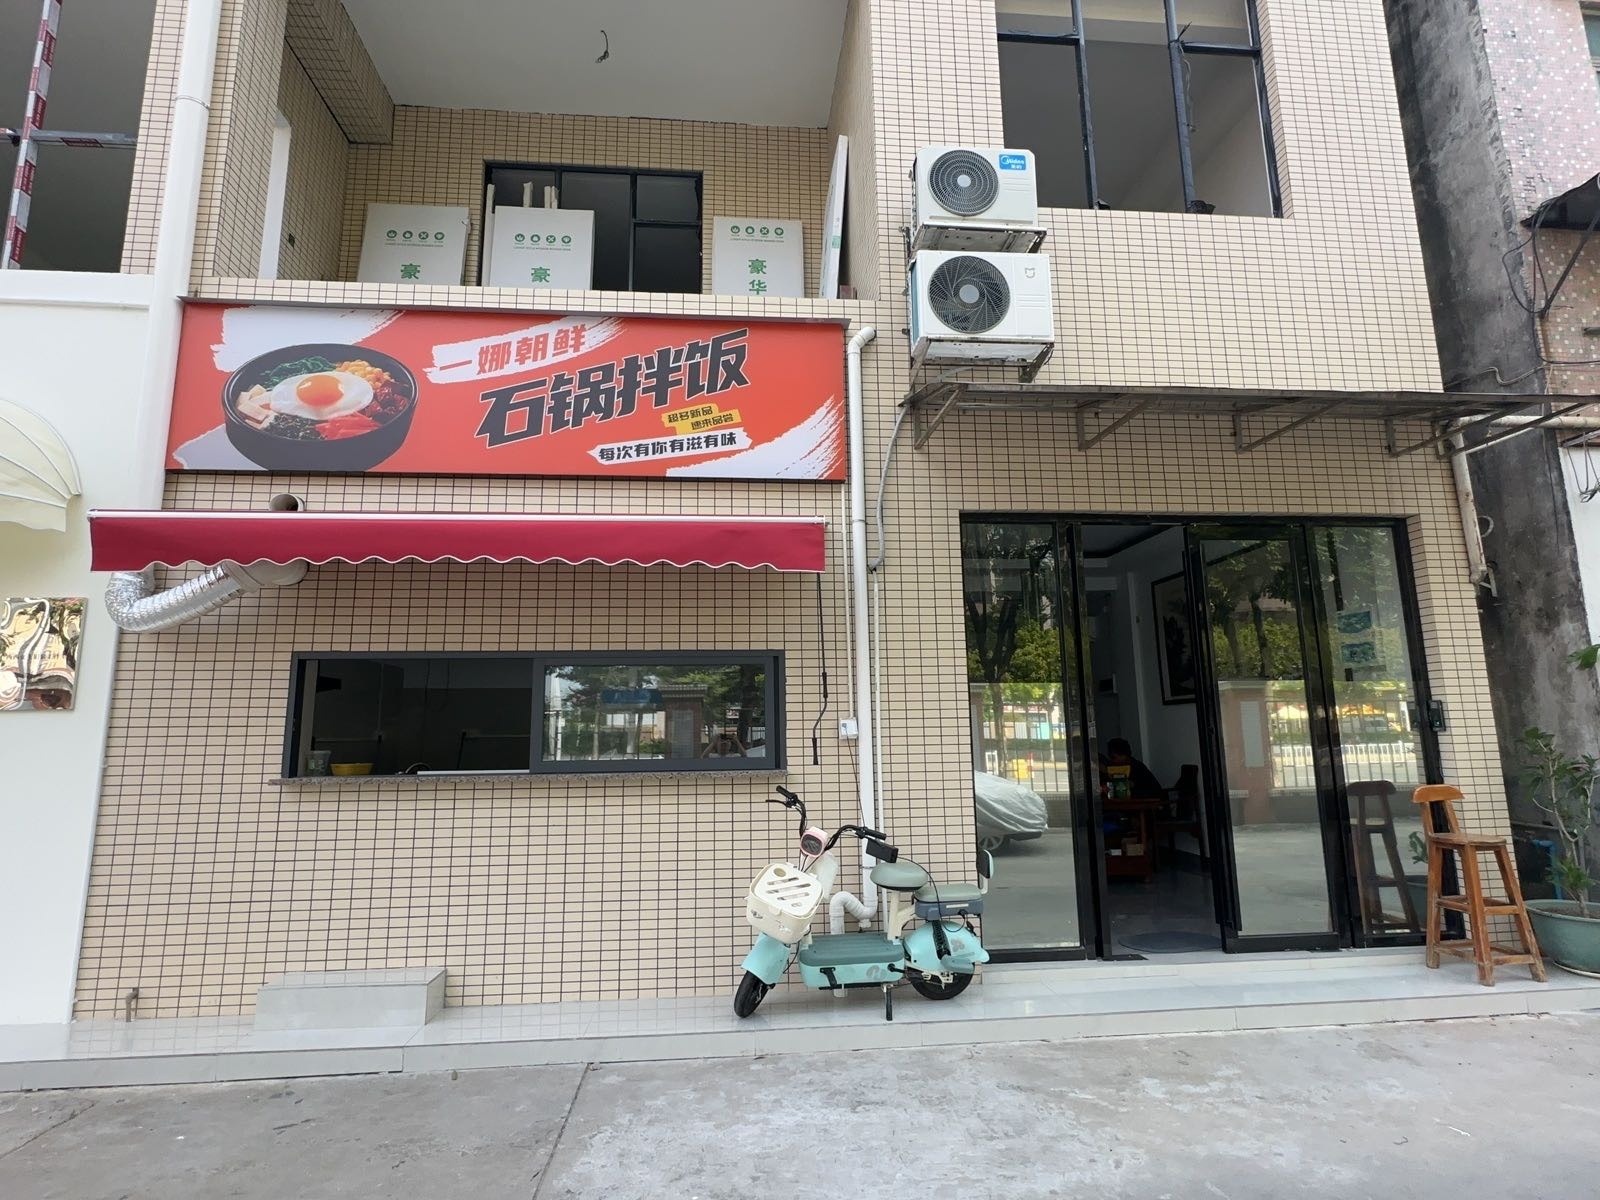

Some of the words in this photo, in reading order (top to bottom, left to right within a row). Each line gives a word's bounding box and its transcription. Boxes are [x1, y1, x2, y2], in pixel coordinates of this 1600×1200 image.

[748, 259, 767, 295] 豪华
[439, 324, 587, 375] 一娜朝鲜
[475, 329, 750, 448] 石锅拌饭
[667, 406, 713, 423] 超多新品
[691, 413, 734, 430] 速来品尝
[598, 432, 737, 461] 每次有你有滋有味
